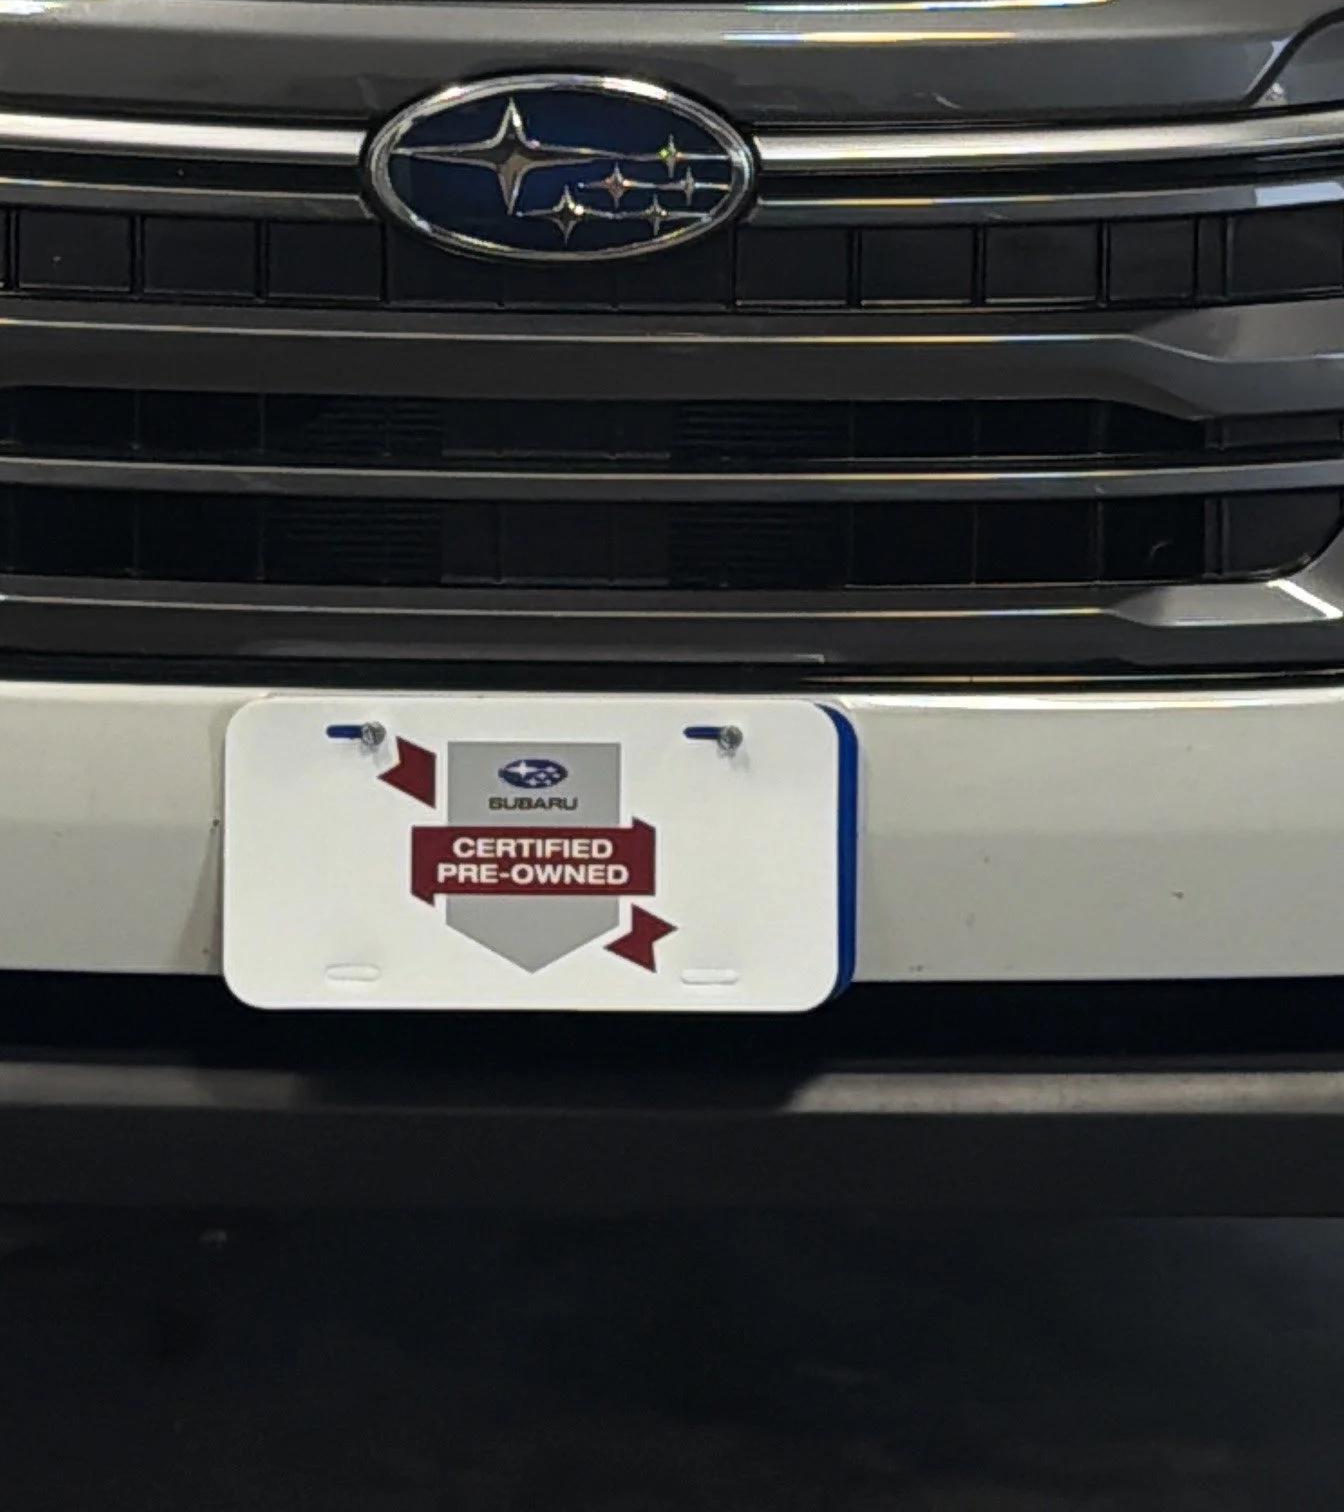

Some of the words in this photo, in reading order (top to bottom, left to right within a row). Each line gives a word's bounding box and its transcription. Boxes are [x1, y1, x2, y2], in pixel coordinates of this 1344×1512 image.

[488, 796, 579, 812] SUBARU
[451, 837, 615, 860] CERTIFIED
[436, 862, 630, 886] PRE-OWNED
